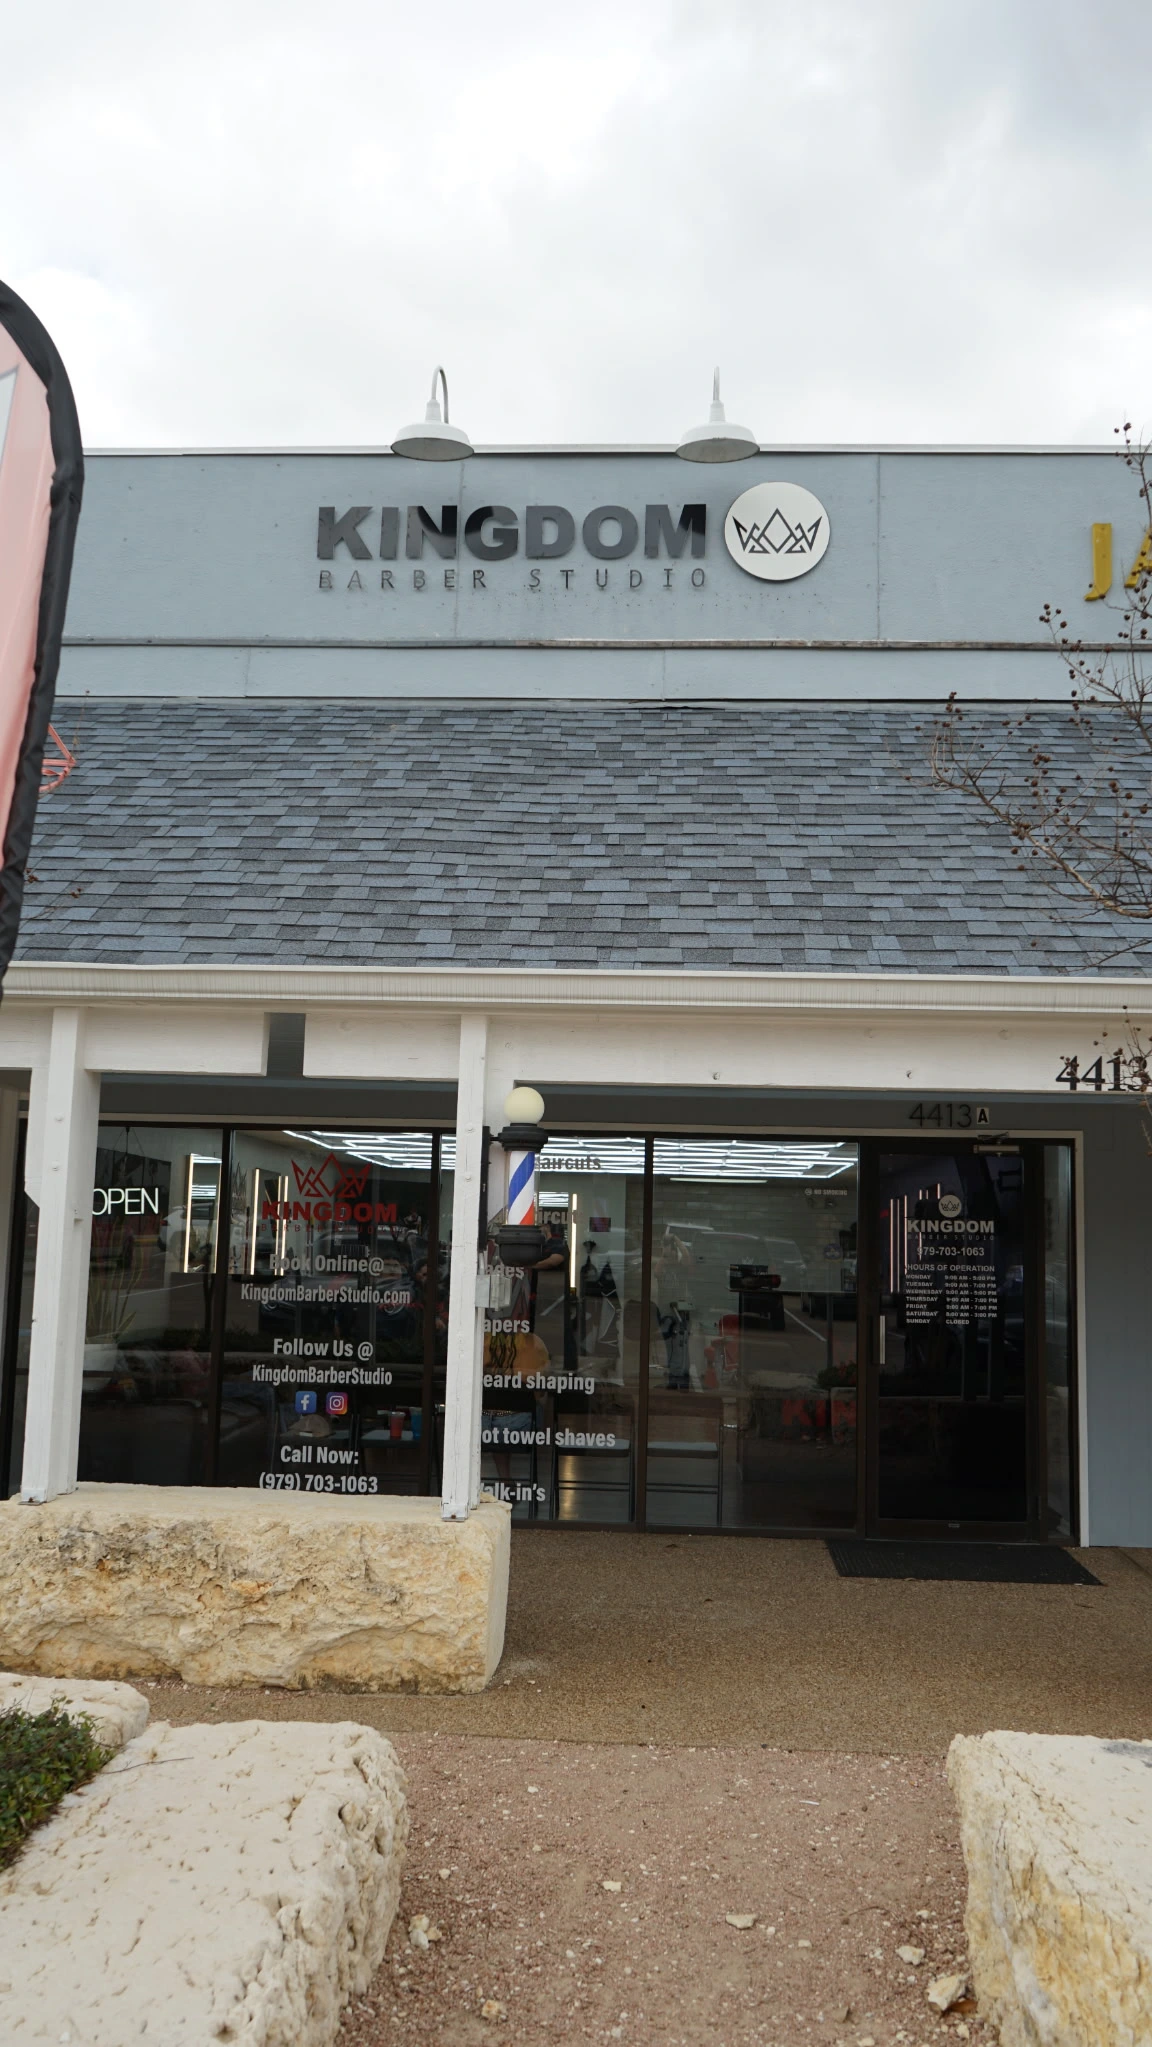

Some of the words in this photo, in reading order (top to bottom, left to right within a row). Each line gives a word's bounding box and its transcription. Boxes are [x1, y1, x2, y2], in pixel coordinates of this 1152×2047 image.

[317, 503, 707, 561] KINGDOM
[318, 569, 487, 590] BARBER
[529, 568, 707, 590] STUDIO
[1056, 1055, 1148, 1091] 4413
[909, 1103, 973, 1128] 4413
[976, 1107, 989, 1124] A
[536, 1154, 602, 1171] aircuts
[92, 1187, 159, 1216] OPEN
[261, 1201, 397, 1224] KINGDOM
[907, 1220, 995, 1233] KINGDOM
[917, 1246, 985, 1256] 979-703-1063
[269, 1254, 312, 1270] Book
[315, 1255, 385, 1276] Online@
[907, 1263, 935, 1271] HOURS
[950, 1264, 995, 1272] OPERATION
[241, 1283, 411, 1305] KingdomBarberStudio.com
[483, 1319, 530, 1336] apers
[273, 1338, 329, 1356] Follow
[332, 1340, 354, 1357] Us
[252, 1364, 392, 1386] KingdomBarberStudio
[482, 1371, 522, 1389] eard
[525, 1372, 596, 1395] shaping
[481, 1426, 500, 1444] ot
[503, 1427, 551, 1446] towel
[555, 1428, 616, 1447] shaves
[280, 1445, 313, 1463] Call
[316, 1446, 359, 1465] Now:
[259, 1472, 301, 1491] (979)
[304, 1474, 378, 1493] 703-1063
[480, 1482, 546, 1502] alk-in's
